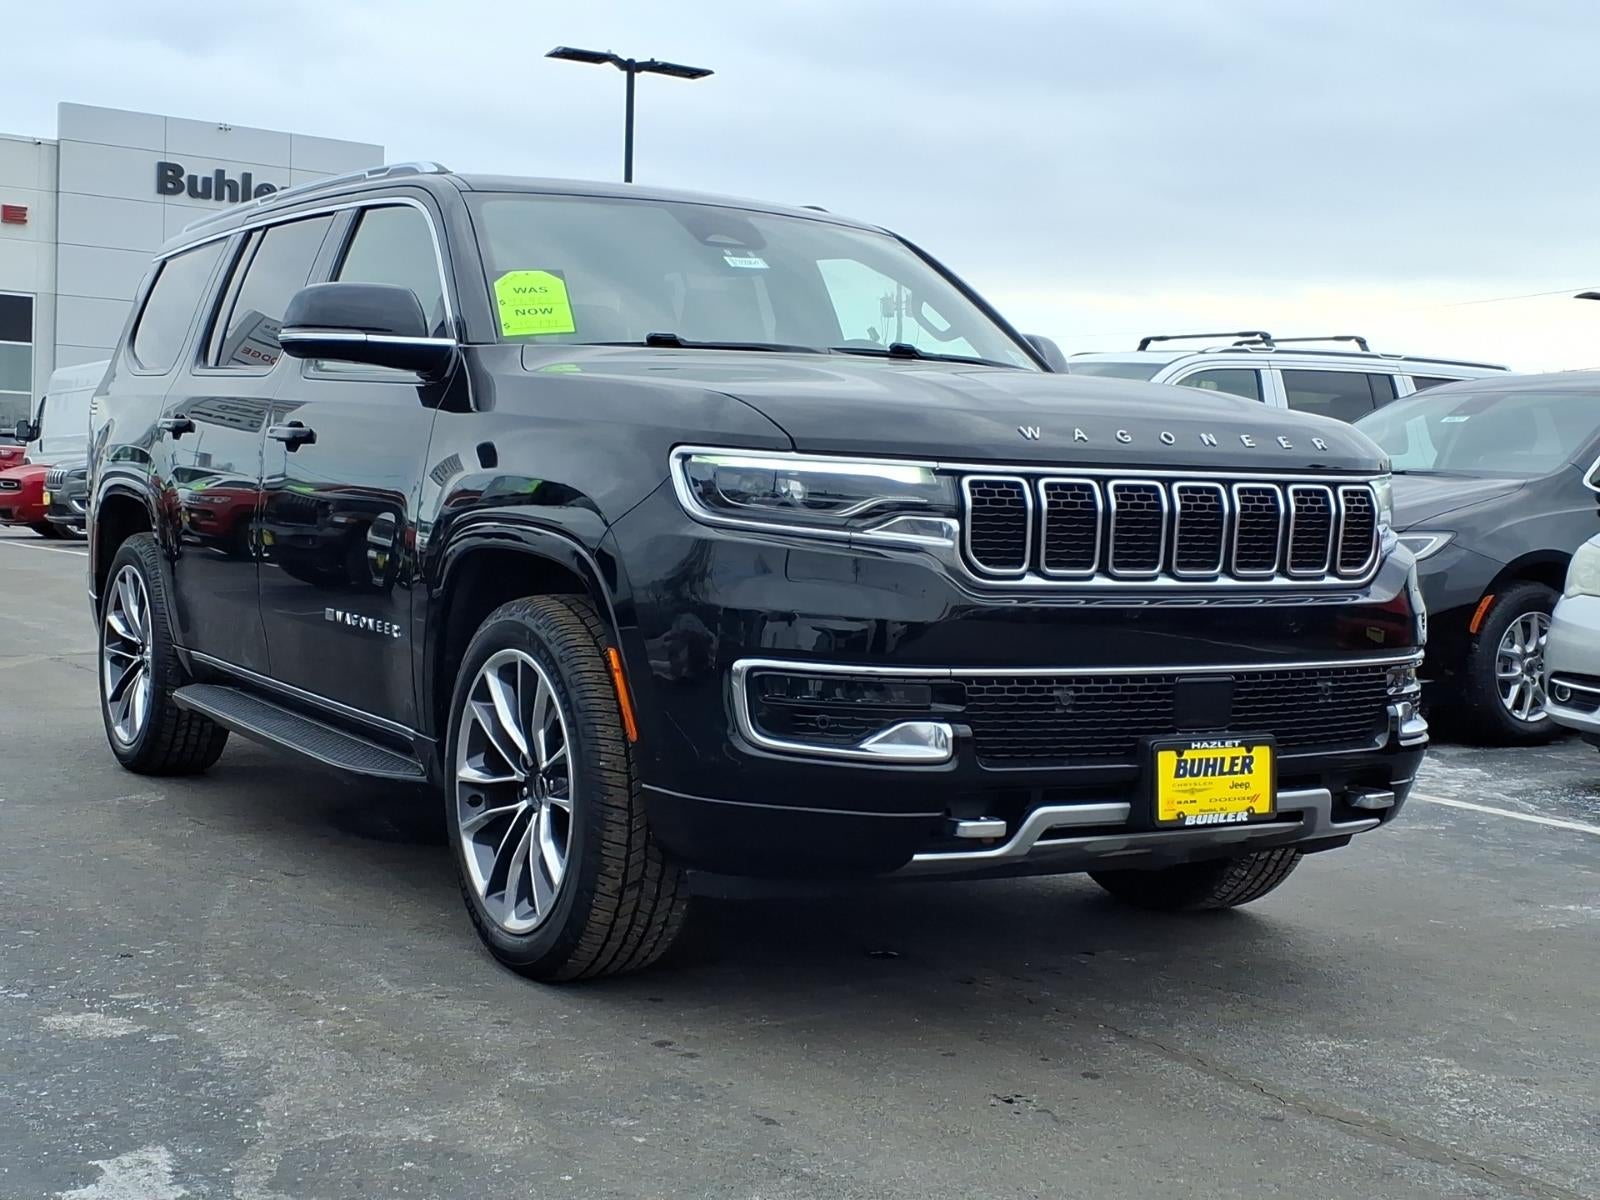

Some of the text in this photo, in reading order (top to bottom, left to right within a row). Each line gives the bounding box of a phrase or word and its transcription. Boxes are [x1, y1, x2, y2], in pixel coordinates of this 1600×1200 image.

[156, 161, 290, 203] Buhle
[513, 286, 548, 294] WAS
[515, 307, 553, 316] NOW
[1017, 424, 1328, 450] WAGONEER
[1191, 740, 1241, 749] HAZLET
[1173, 755, 1254, 779] BUHLER
[1229, 781, 1250, 790] Jeep
[1185, 811, 1248, 826] BUHLER
